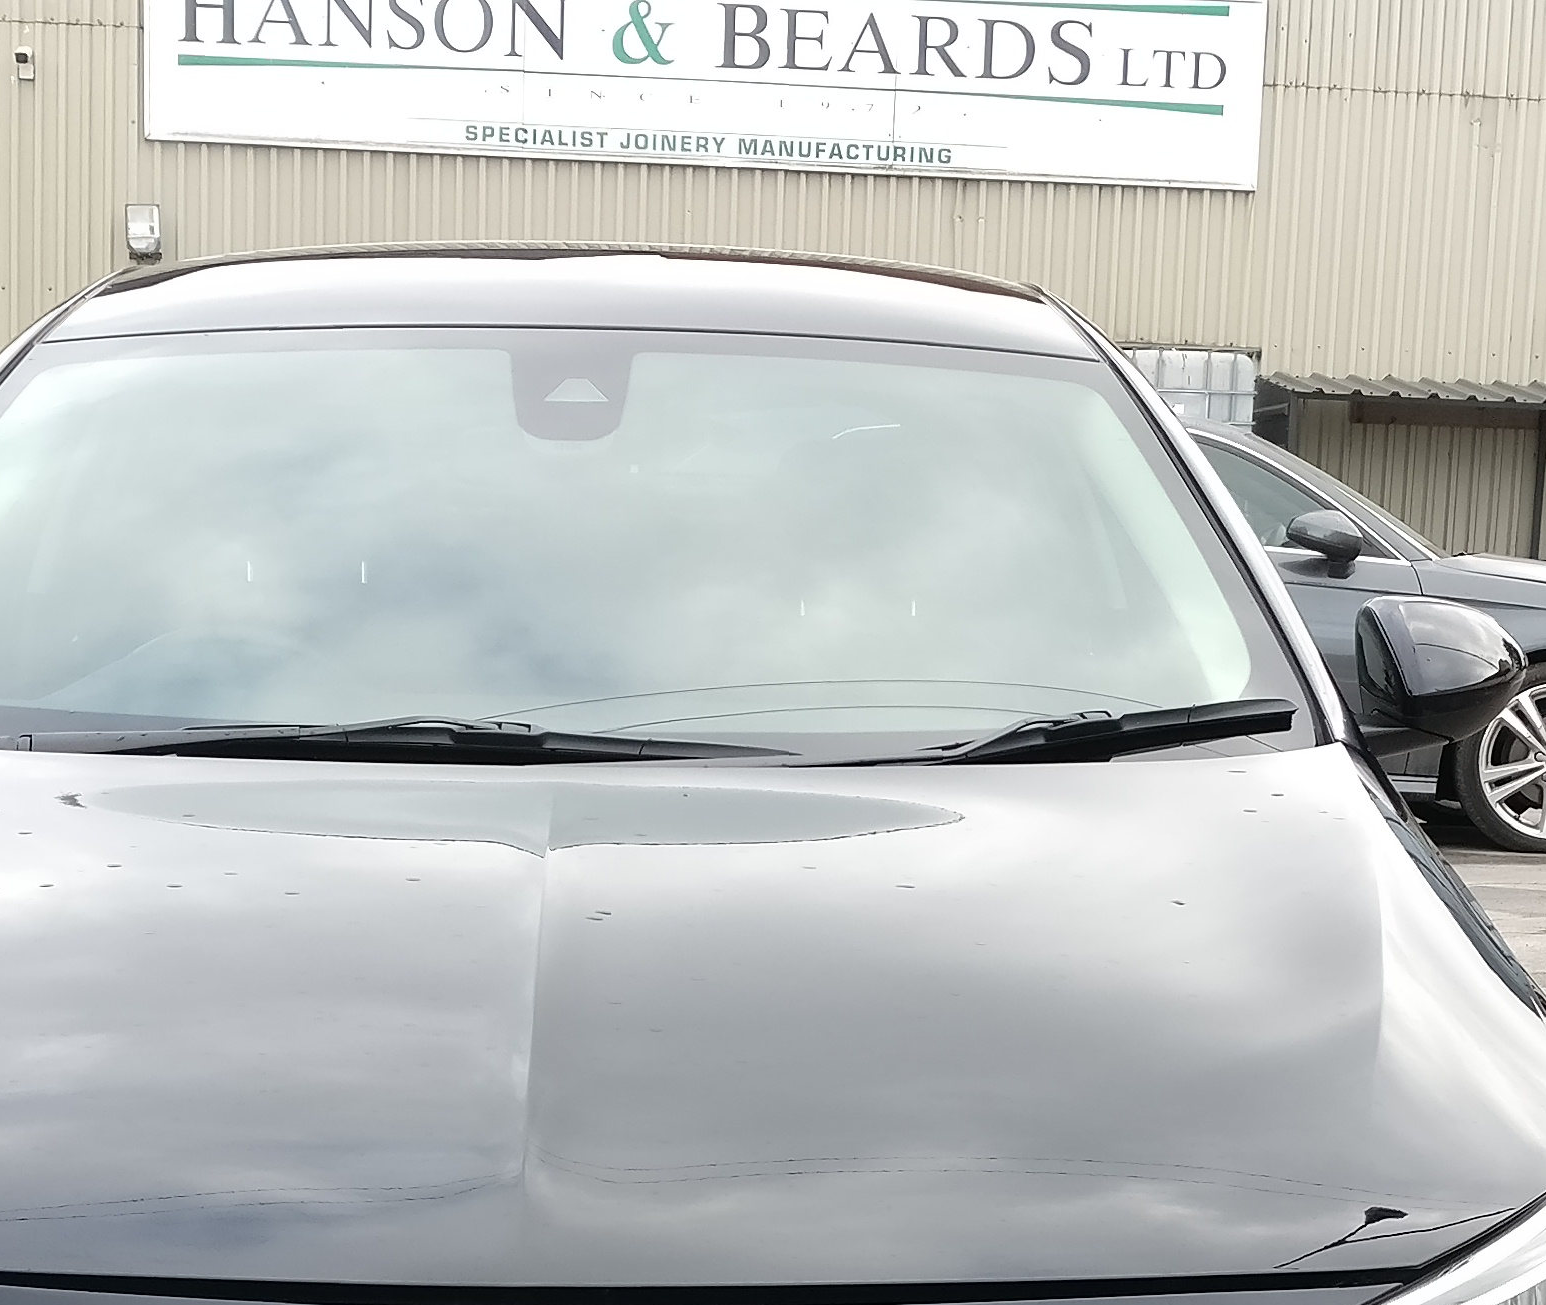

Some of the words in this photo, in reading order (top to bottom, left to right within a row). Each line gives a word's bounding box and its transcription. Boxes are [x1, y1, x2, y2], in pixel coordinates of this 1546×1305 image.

[177, 0, 565, 60] HANSON
[612, 0, 675, 65] &
[714, 2, 1094, 86] BEARDS
[1116, 47, 1228, 90] LTD
[464, 125, 609, 149] SPECIALIST
[619, 132, 727, 154] JOINERY
[738, 137, 953, 165] MANUFACTURING
